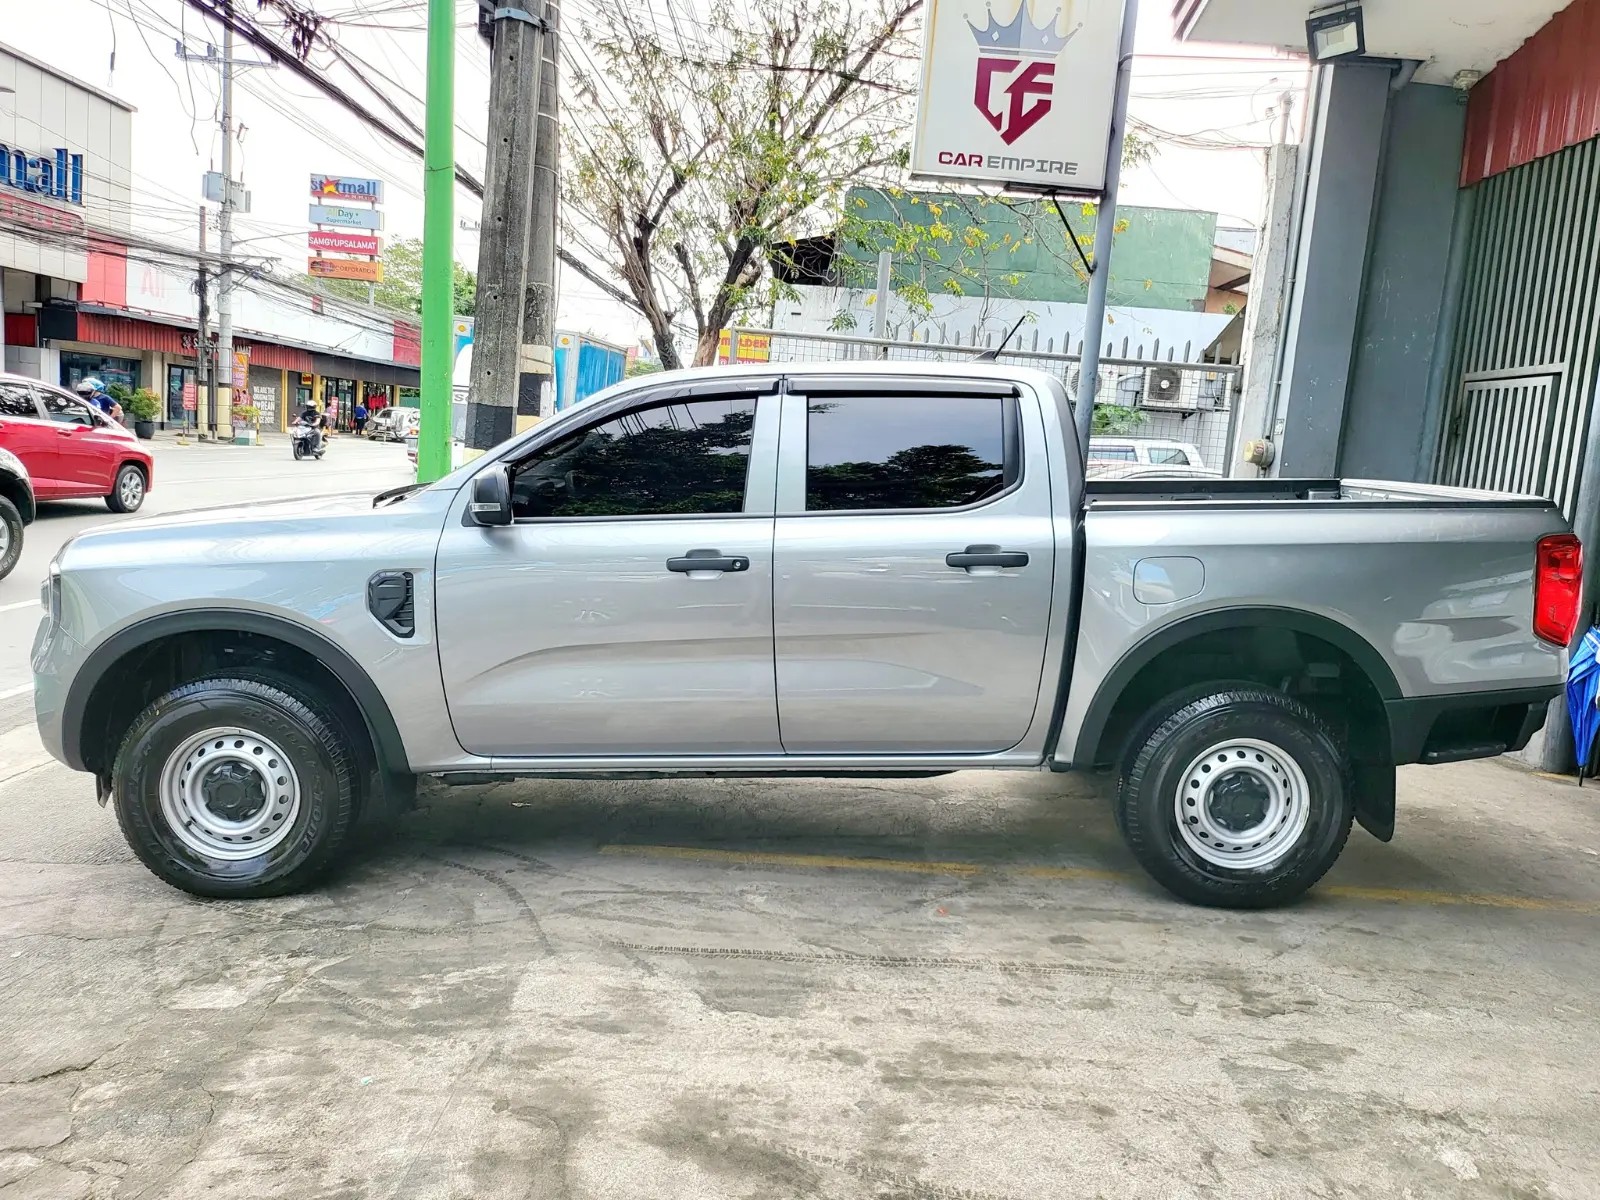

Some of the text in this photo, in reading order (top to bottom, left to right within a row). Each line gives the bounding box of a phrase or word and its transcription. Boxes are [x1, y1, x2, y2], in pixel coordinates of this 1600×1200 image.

[938, 151, 1078, 176] CAR EMPIRE
[310, 179, 376, 195] strmall
[309, 236, 377, 250] SAMGYUPSALAMAT
